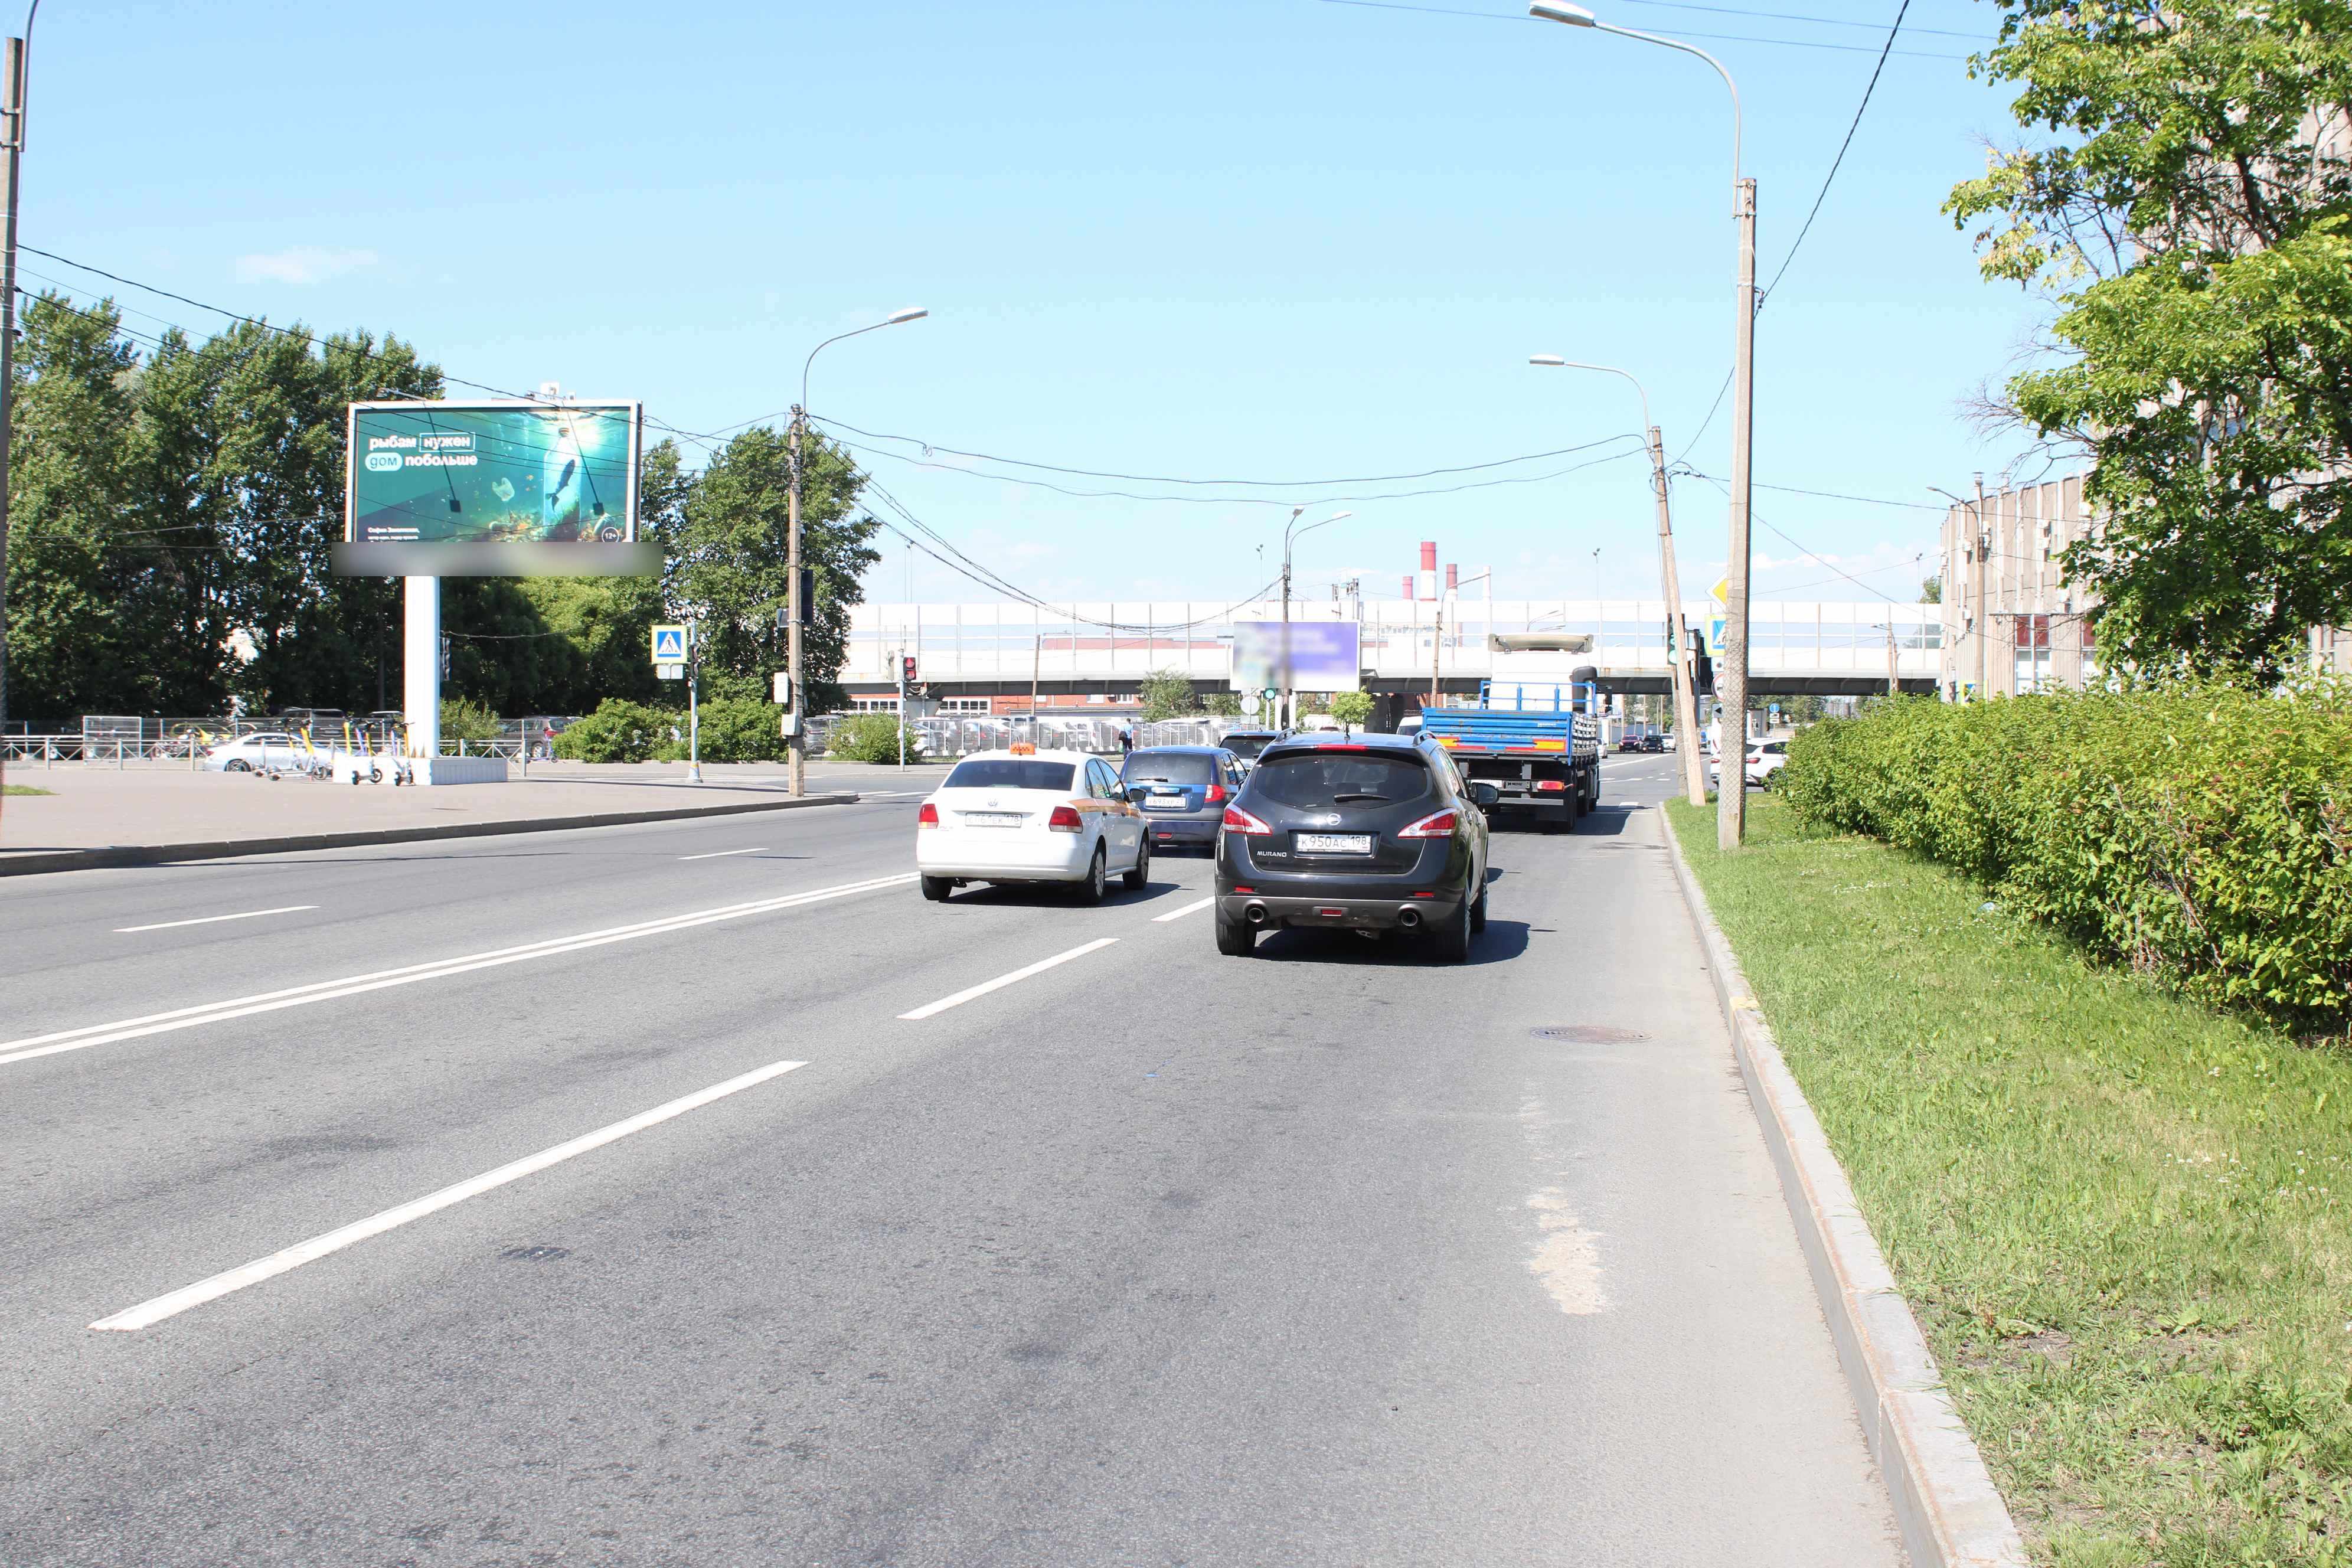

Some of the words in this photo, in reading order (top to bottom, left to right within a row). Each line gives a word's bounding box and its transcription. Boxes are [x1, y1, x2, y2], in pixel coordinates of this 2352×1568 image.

[369, 435, 417, 450] рыбам
[423, 437, 471, 449] нужен
[370, 457, 397, 469] дом
[405, 453, 478, 466] побольше
[1301, 836, 1347, 848] К950АС
[1351, 836, 1366, 845] 198
